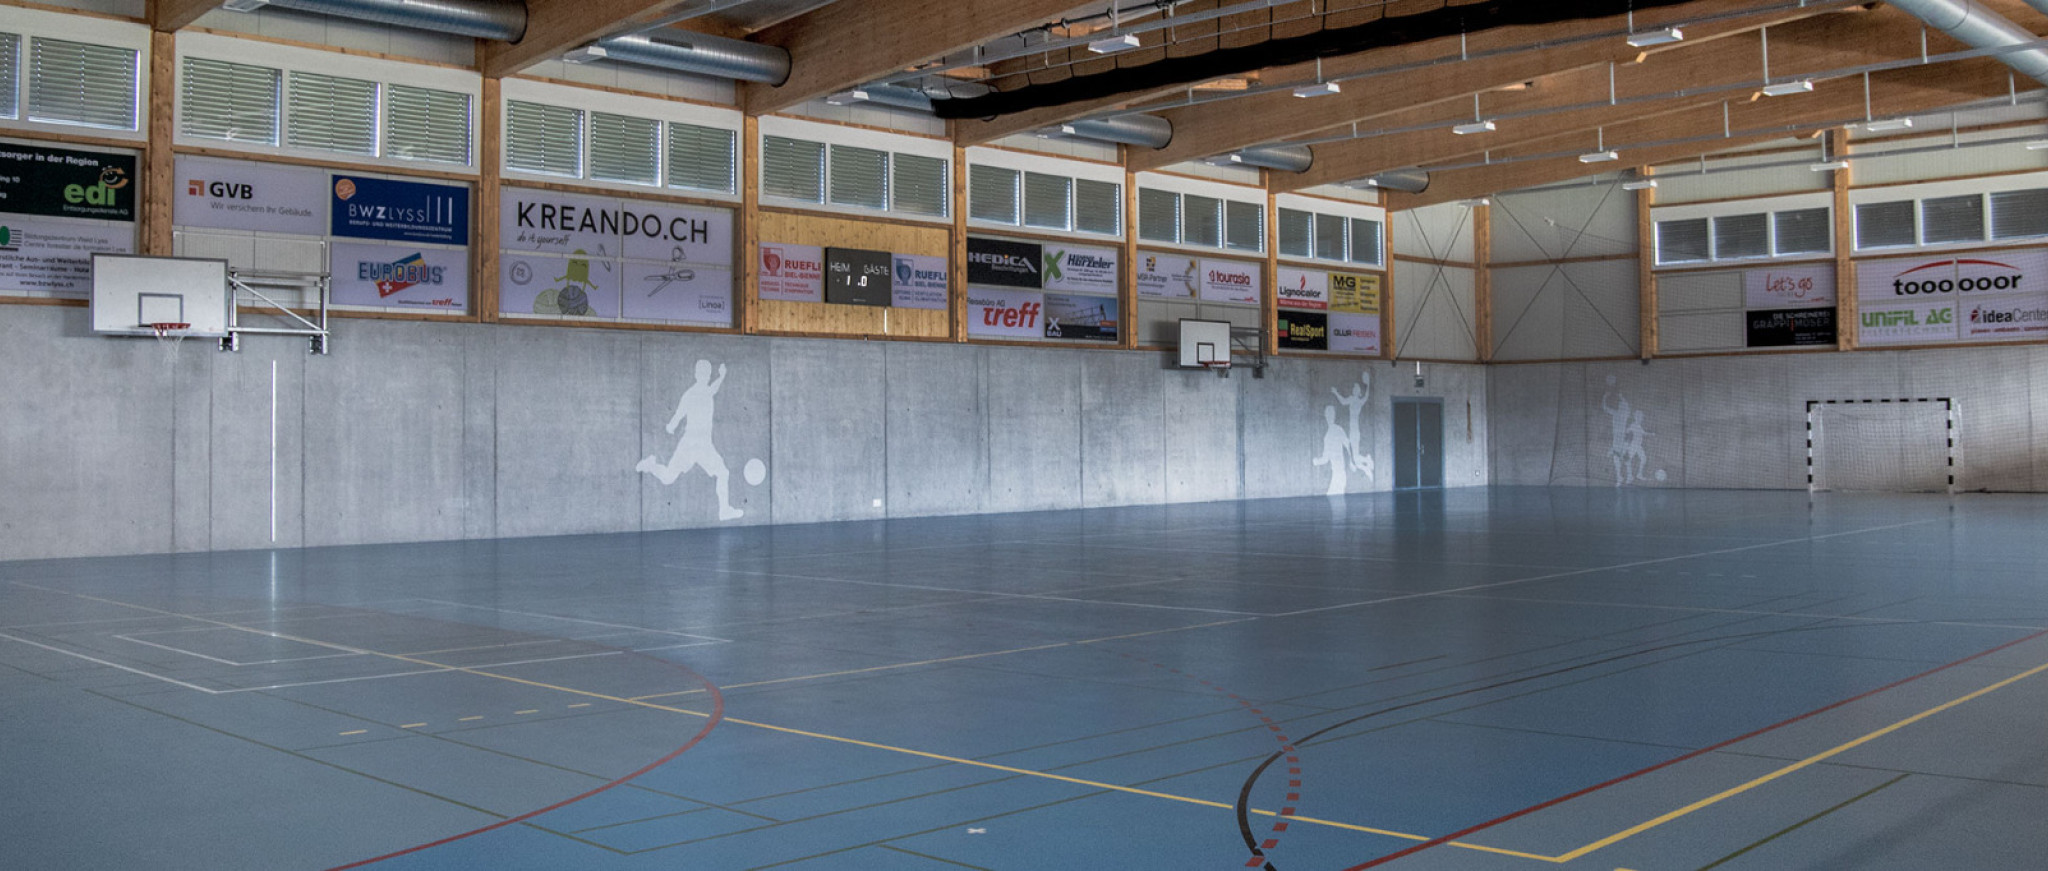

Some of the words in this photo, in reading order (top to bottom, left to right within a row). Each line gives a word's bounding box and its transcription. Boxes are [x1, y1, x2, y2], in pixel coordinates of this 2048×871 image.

[35, 152, 45, 161] in
[47, 153, 64, 163] der
[66, 155, 99, 167] Region
[64, 180, 116, 206] edi
[209, 182, 254, 199] GVB
[518, 201, 707, 244] KREANDO.CH
[536, 234, 571, 250] yourself
[358, 261, 443, 286] EUROBUS
[784, 259, 821, 271] RUEFLI
[830, 261, 851, 272] HEIM
[863, 263, 889, 276] GÄSTE
[983, 302, 1041, 328] treff
